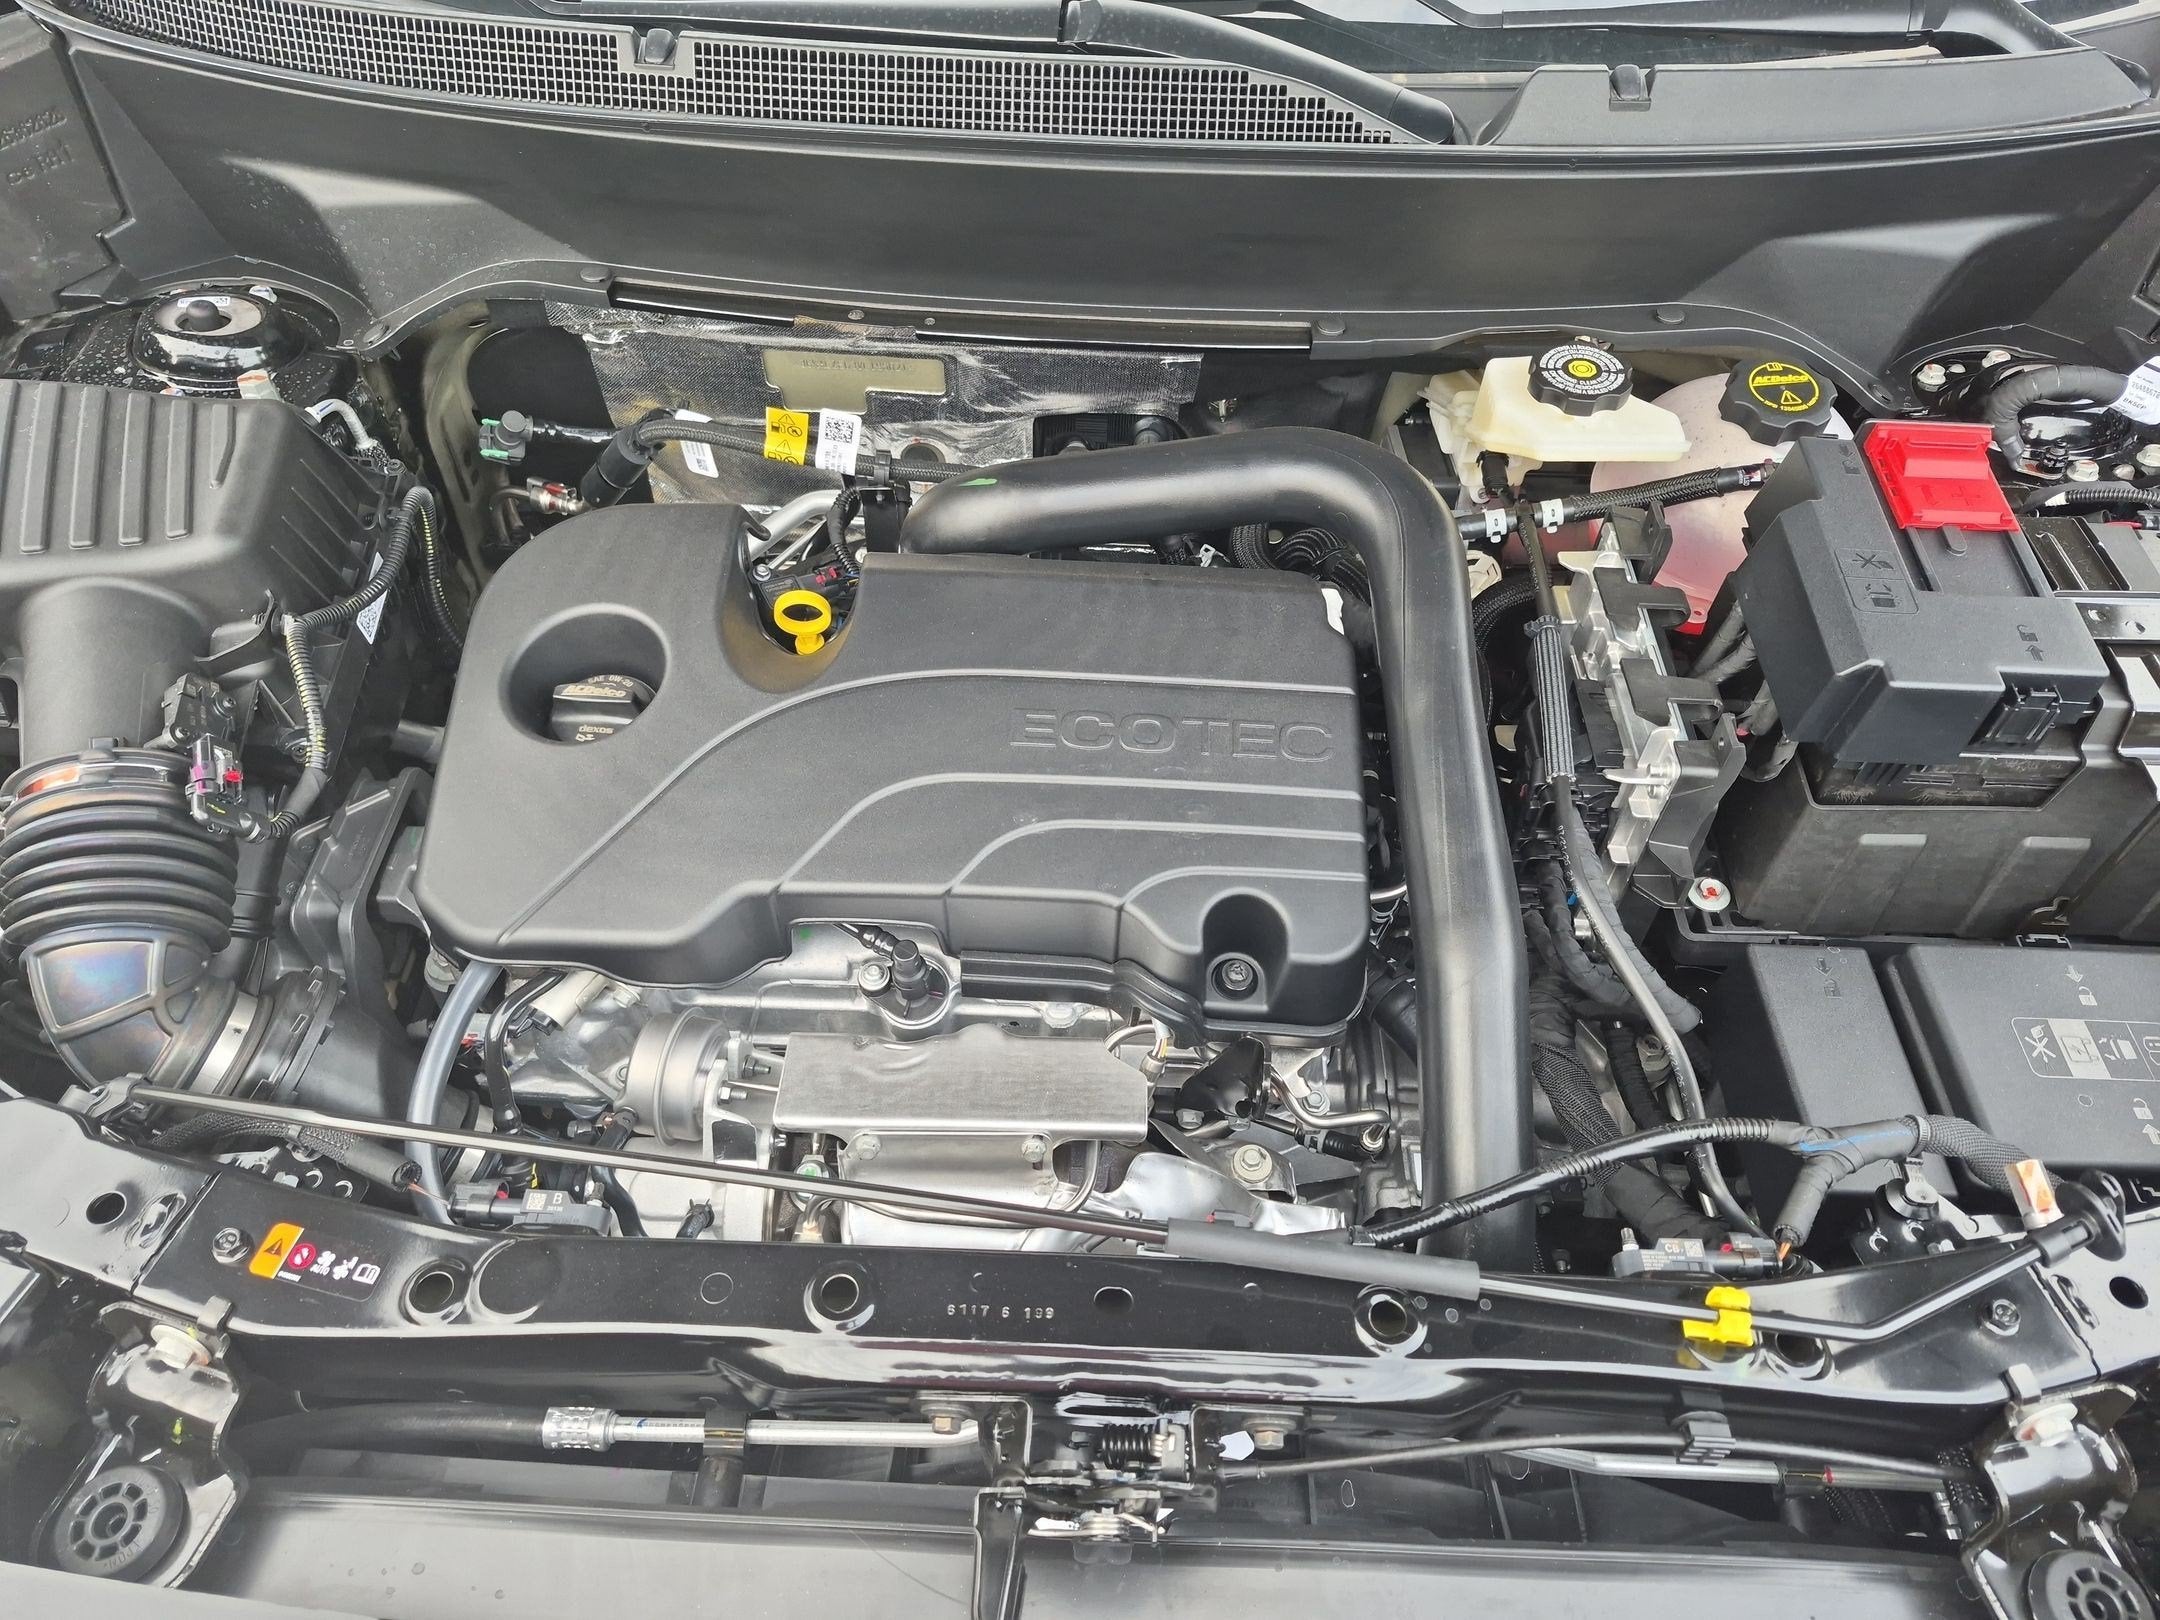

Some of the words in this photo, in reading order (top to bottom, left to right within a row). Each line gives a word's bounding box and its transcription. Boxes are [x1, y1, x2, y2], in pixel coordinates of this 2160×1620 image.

[1753, 374, 1809, 384] ACDelco
[1565, 386, 1582, 394] FROM
[561, 684, 627, 697] ACDelco
[579, 724, 615, 734] dexos
[1010, 707, 1333, 763] ECOTEC
[552, 1193, 563, 1204] B
[310, 1263, 331, 1276] AUTO
[1001, 1306, 1010, 1319] 6
